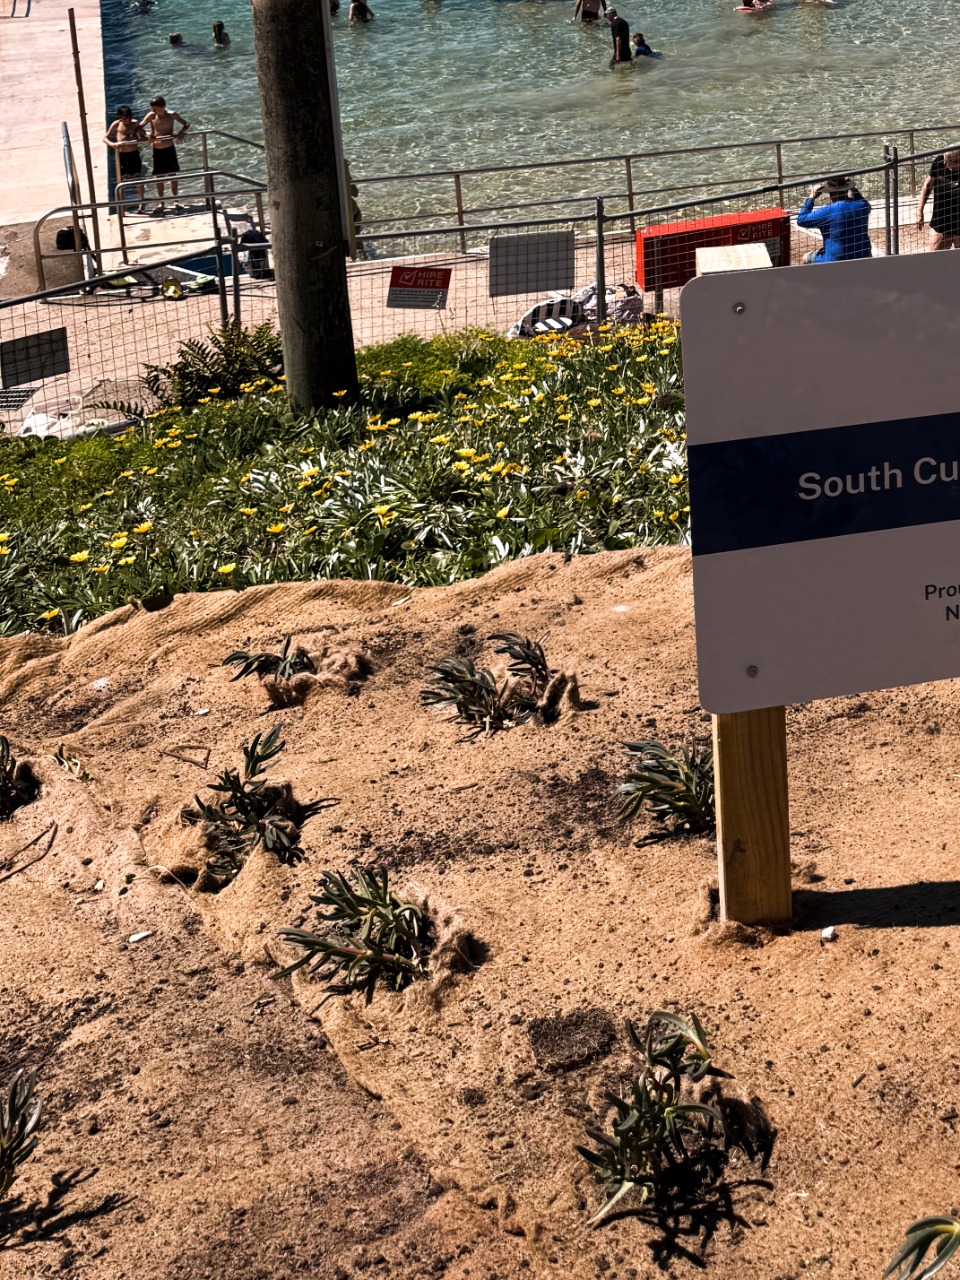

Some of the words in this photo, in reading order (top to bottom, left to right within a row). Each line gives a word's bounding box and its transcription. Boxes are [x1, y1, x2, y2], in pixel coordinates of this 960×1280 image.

[752, 222, 773, 231] HIRE
[417, 271, 445, 279] HIRE
[416, 279, 443, 287] RITE
[798, 461, 903, 500] South
